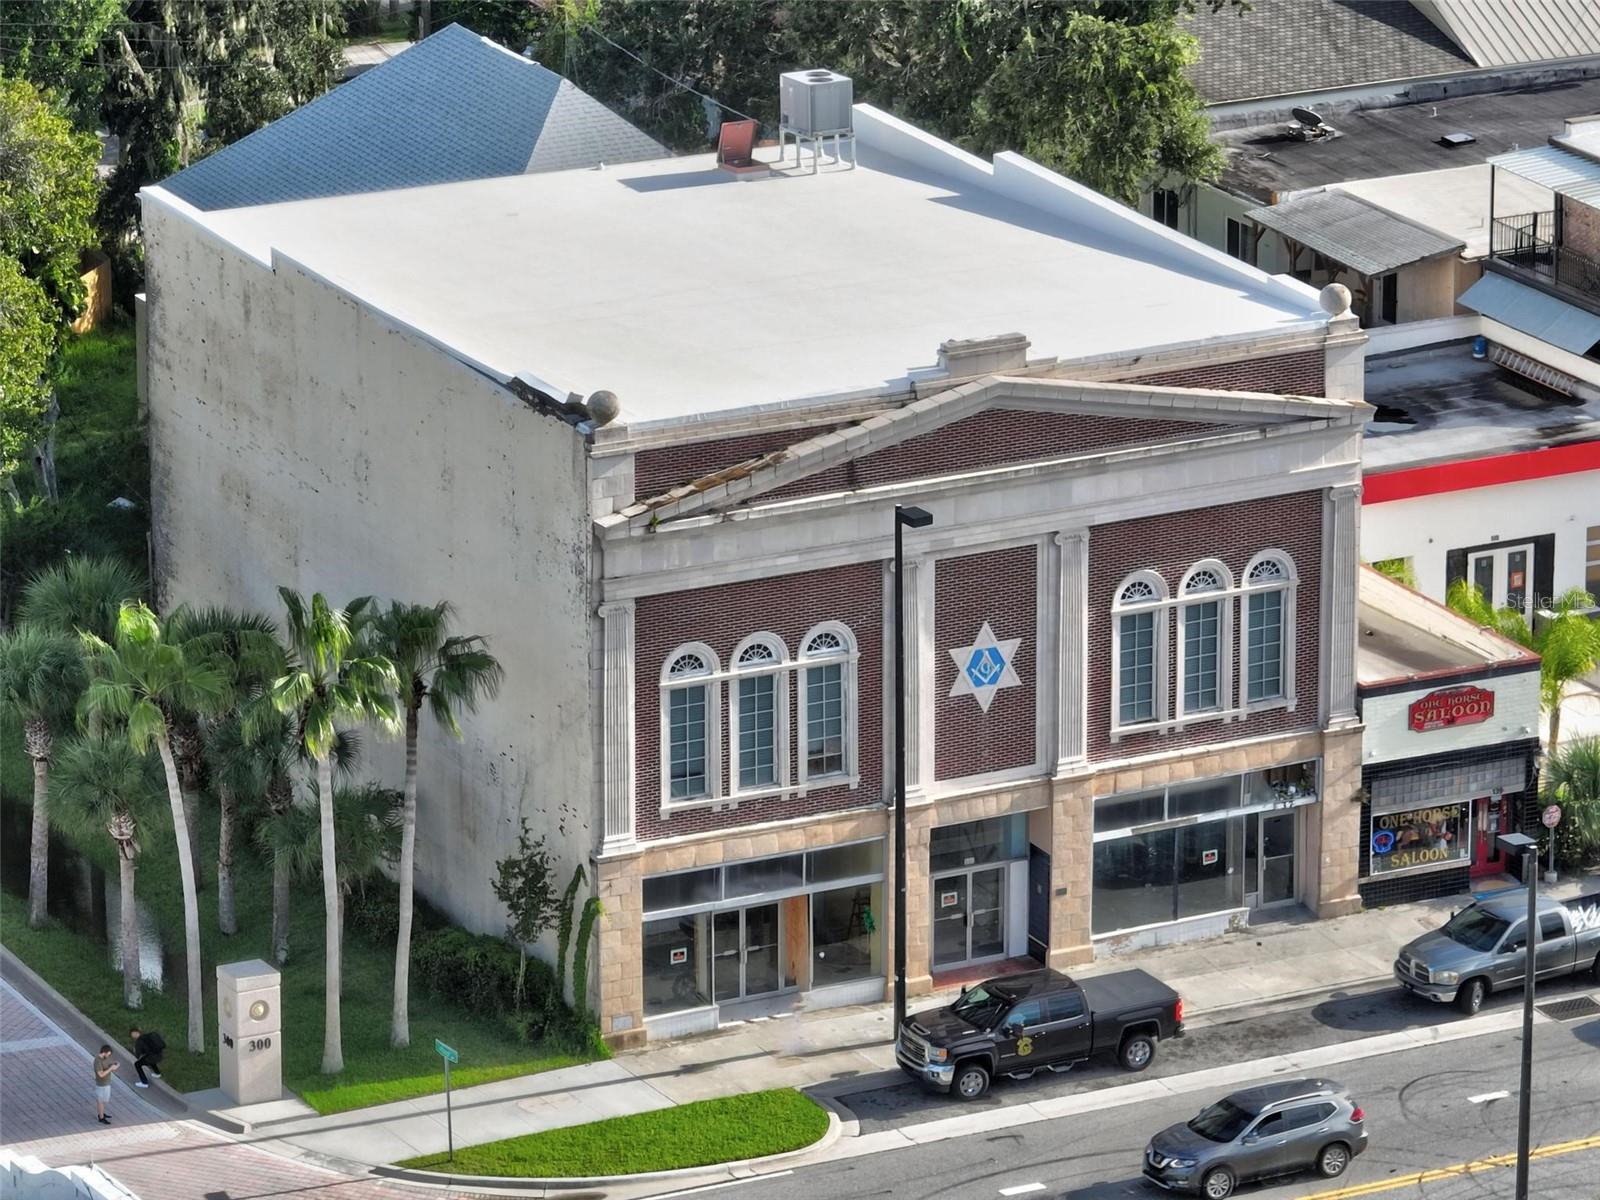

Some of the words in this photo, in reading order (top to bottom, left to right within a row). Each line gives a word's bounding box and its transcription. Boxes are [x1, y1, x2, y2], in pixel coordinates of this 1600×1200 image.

[1414, 700, 1492, 723] SALOON
[1379, 813, 1409, 830] ONE
[1412, 805, 1460, 824] HORSE
[1391, 847, 1449, 868] SALOON
[248, 1037, 272, 1052] 300
